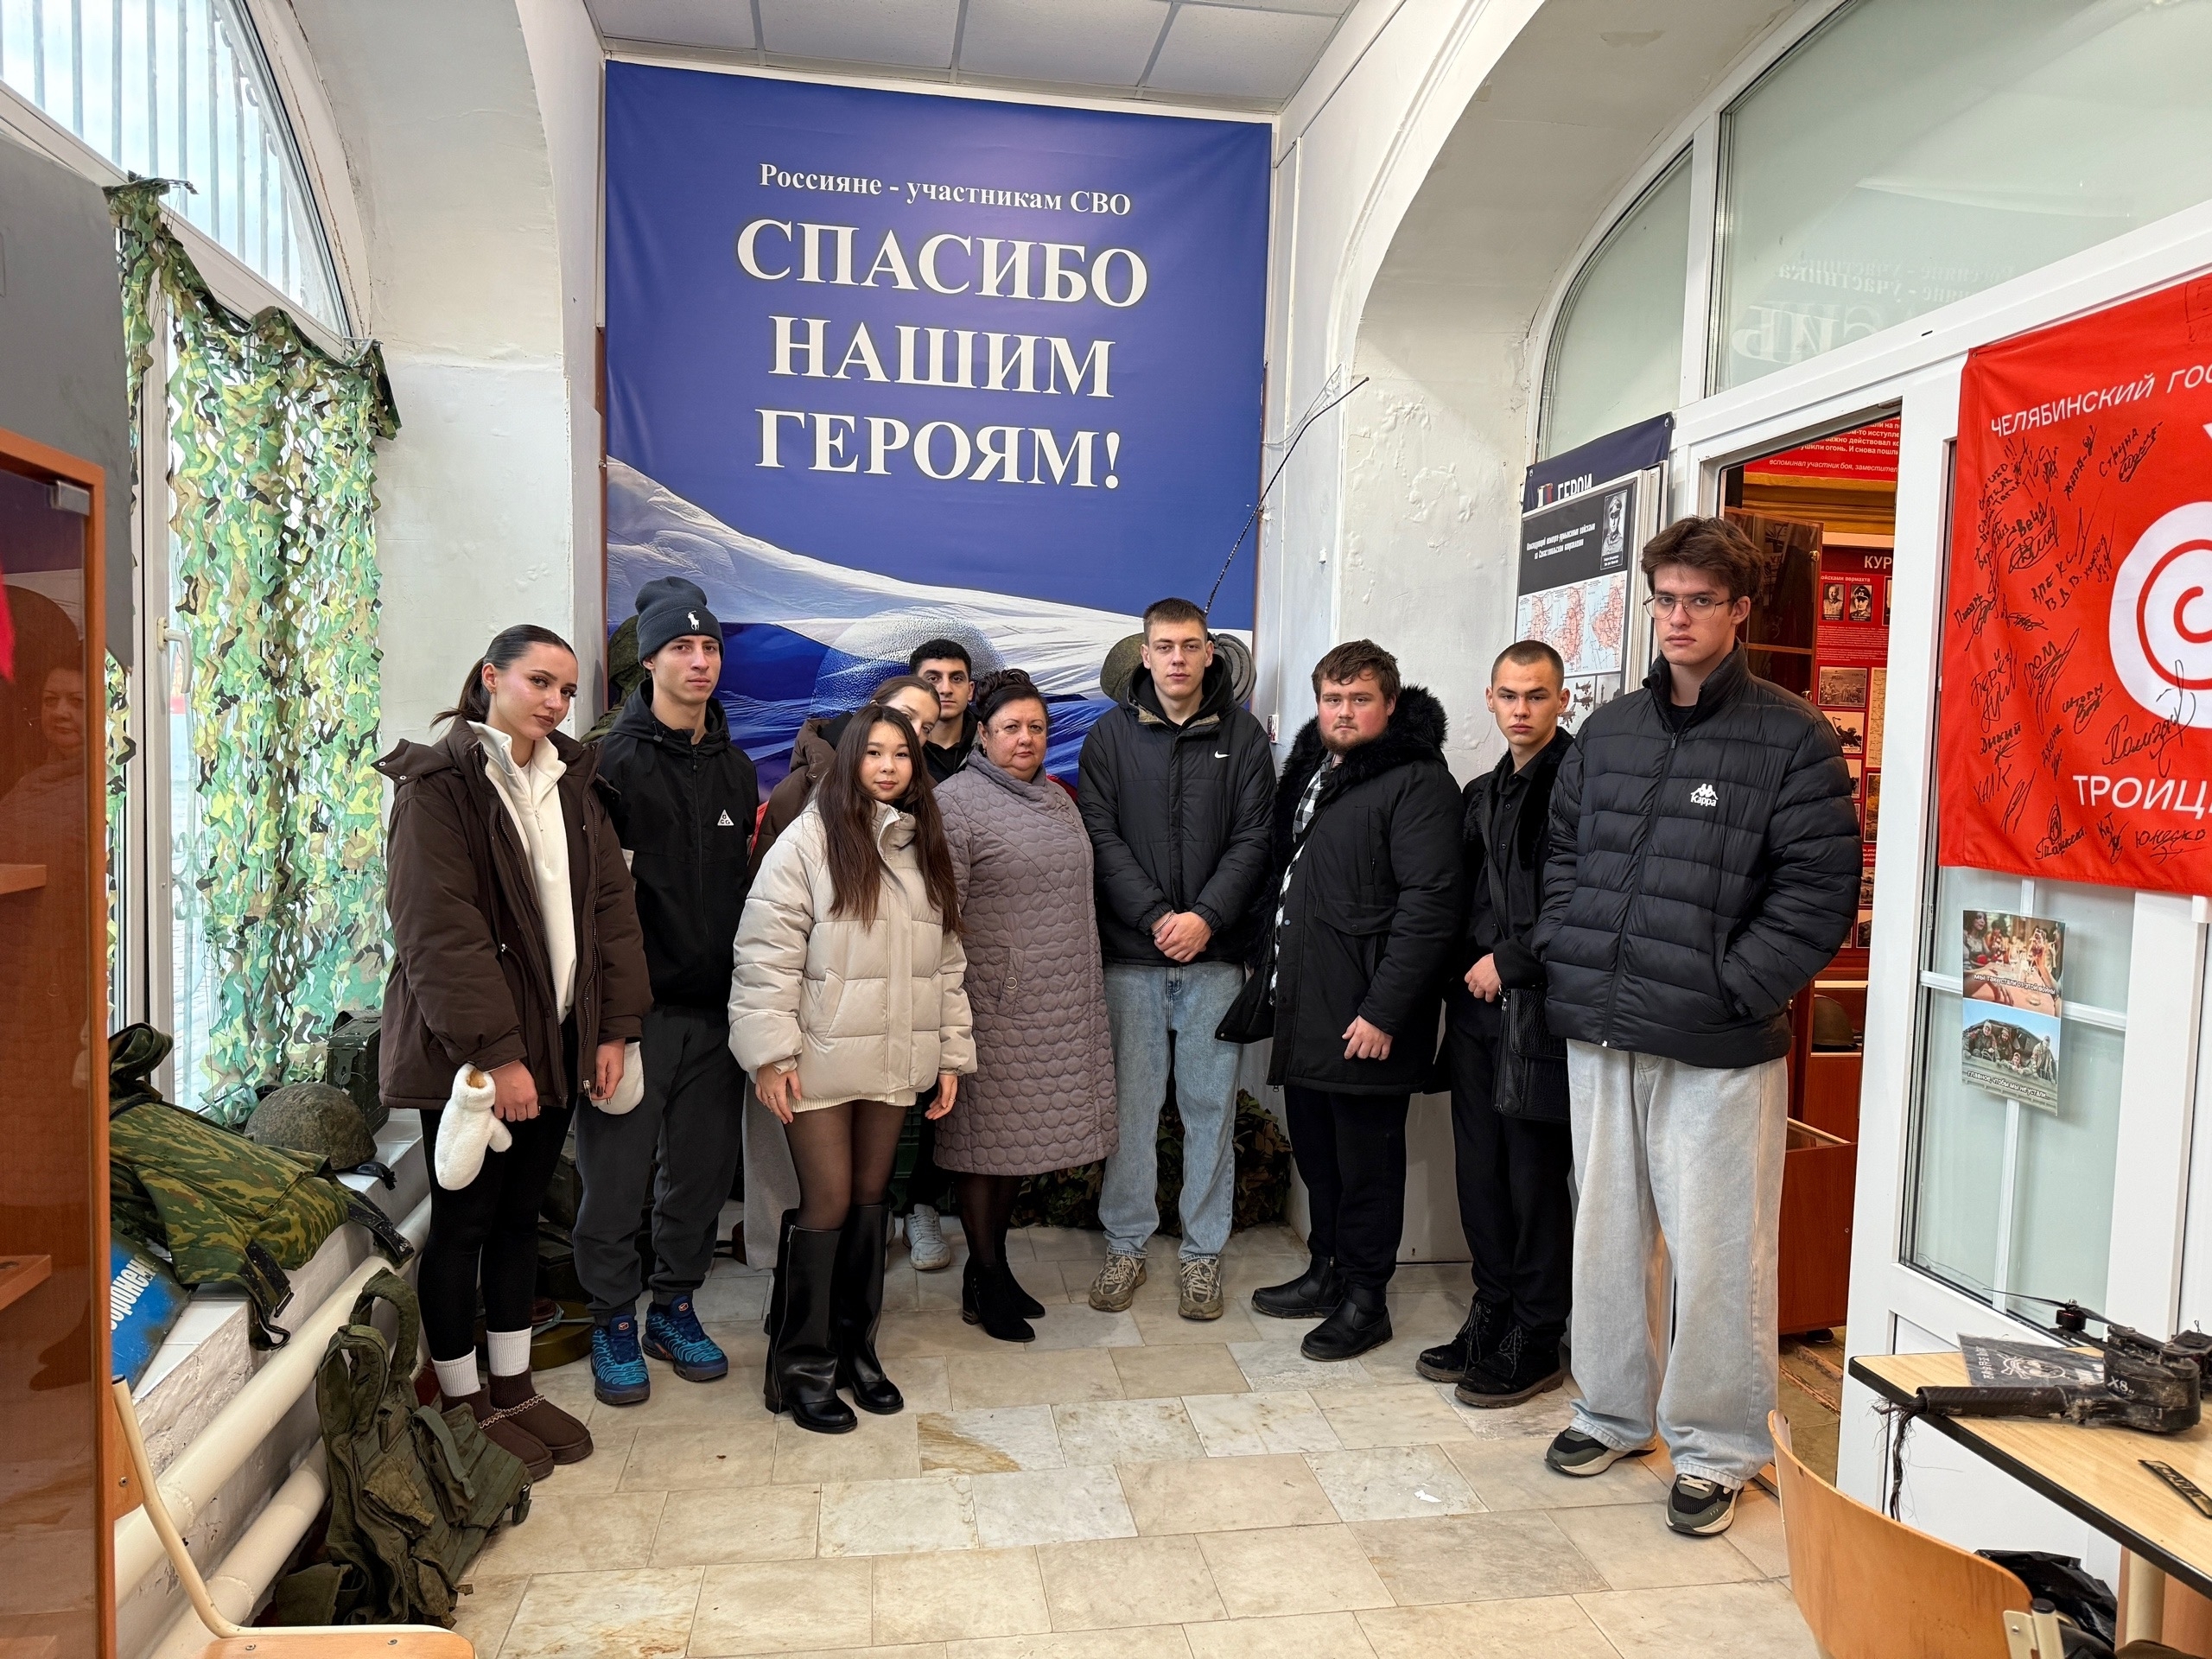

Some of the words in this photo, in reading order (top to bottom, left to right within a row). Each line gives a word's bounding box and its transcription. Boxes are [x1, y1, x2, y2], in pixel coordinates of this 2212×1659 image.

[759, 163, 882, 195] Россияне
[906, 179, 1062, 213] участникам
[1070, 190, 1131, 216] СВО
[736, 219, 1148, 308] СПАСИБО
[768, 315, 1116, 398] НАШИМ
[1991, 372, 2155, 437] ЧЕЛЯБИНСКИЙ
[754, 408, 1122, 490] ГЕРОЯМ!
[1807, 461, 1840, 469] участник
[1849, 438, 1891, 447] действовал
[1690, 795, 1717, 807] Kappa
[2073, 774, 2212, 820] ТРОИЦ
